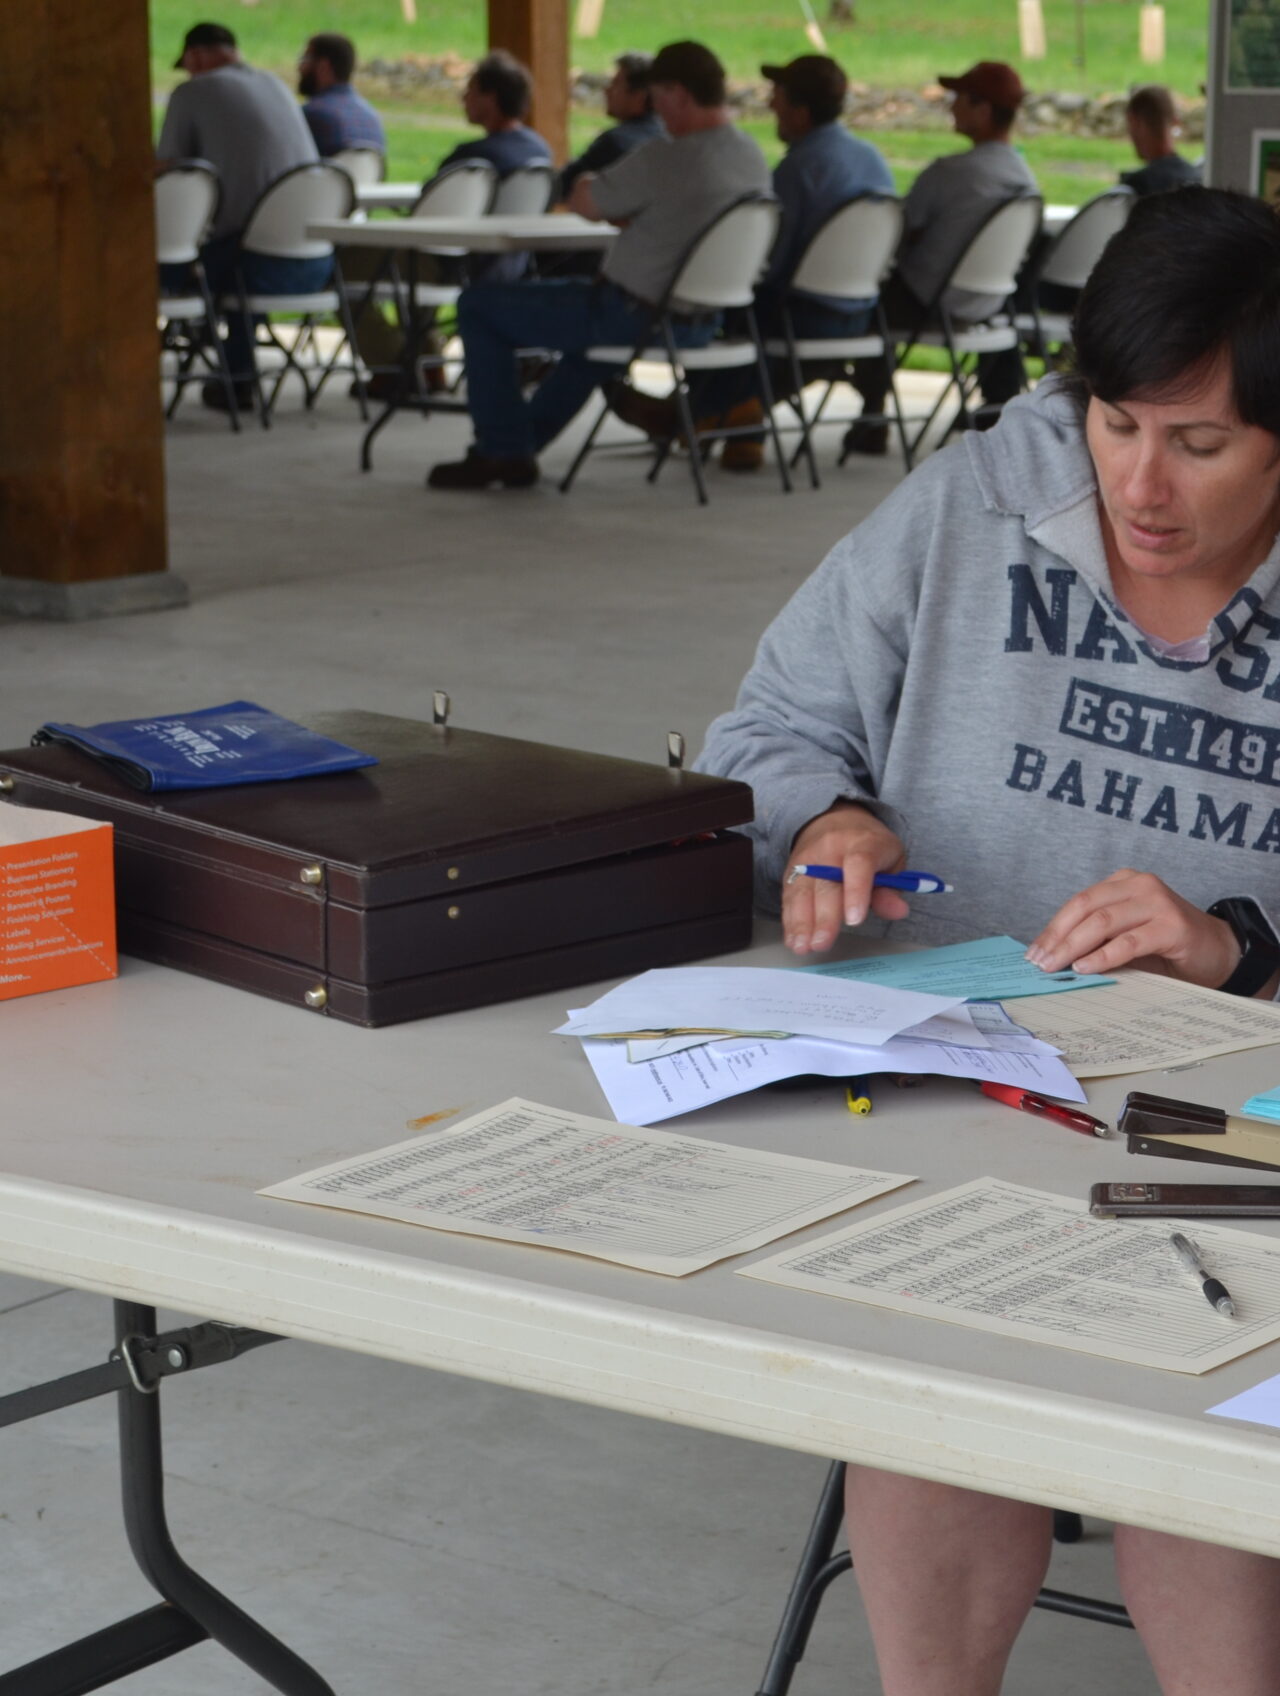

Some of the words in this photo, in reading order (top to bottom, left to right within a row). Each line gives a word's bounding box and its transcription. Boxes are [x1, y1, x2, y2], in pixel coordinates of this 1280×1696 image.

[7, 858, 52, 870] Presentation
[52, 852, 78, 862] Folders
[7, 874, 38, 884] Business
[40, 867, 74, 879] Stationery
[7, 886, 44, 898] Corporate
[45, 880, 78, 891] Branding
[7, 902, 36, 912] Banners
[46, 894, 71, 904] Posters
[7, 914, 40, 924] Finishing
[42, 907, 74, 918] Solutions
[6, 928, 31, 938] Labels
[6, 942, 34, 951] Mailing
[35, 936, 66, 946] Services
